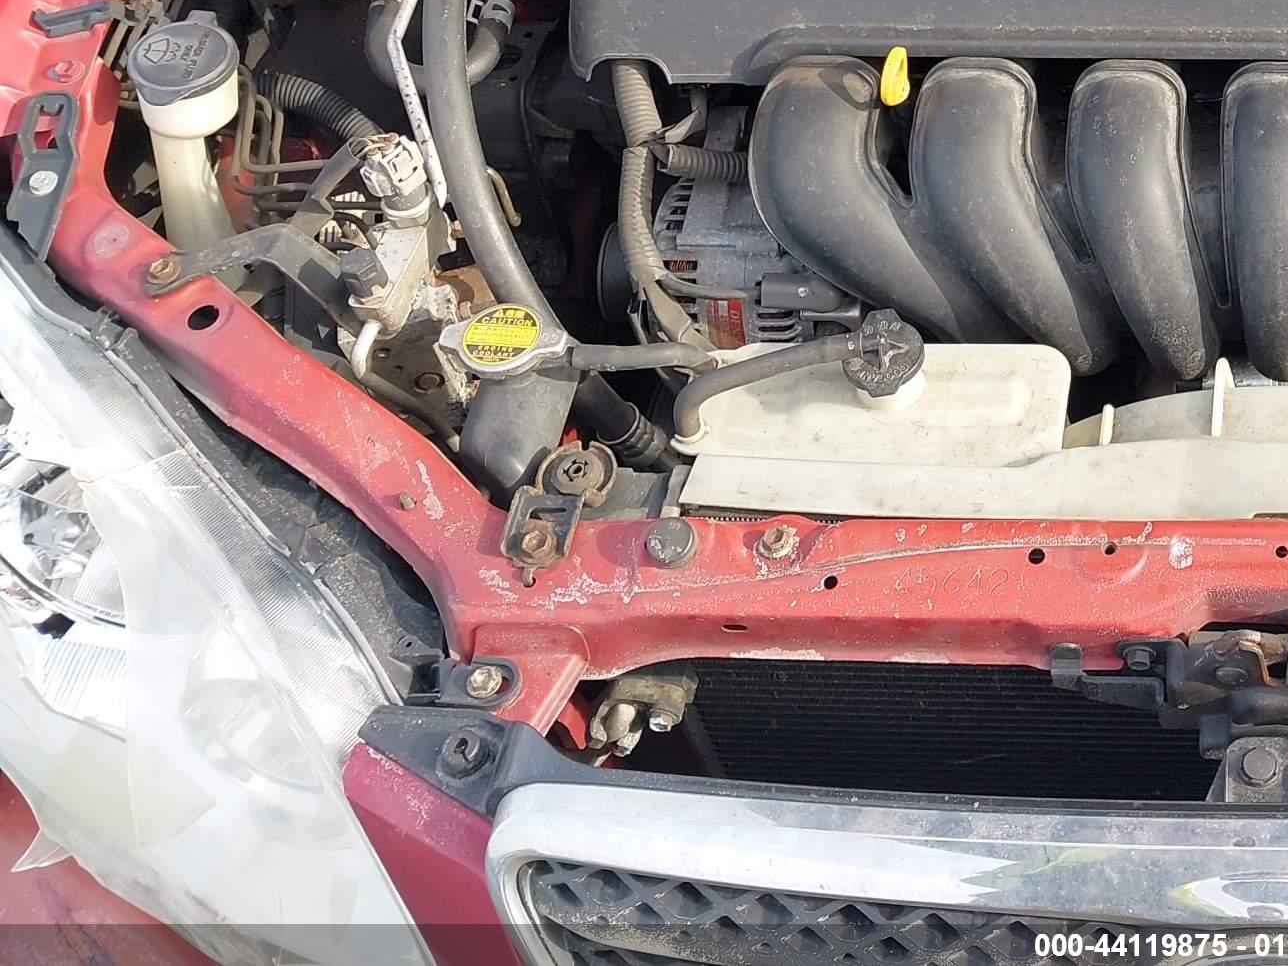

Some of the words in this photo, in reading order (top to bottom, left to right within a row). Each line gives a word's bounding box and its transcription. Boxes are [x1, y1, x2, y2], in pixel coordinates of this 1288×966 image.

[481, 316, 534, 327] CAUTION
[472, 349, 515, 358] COOLANT
[477, 345, 514, 353] ENGINE
